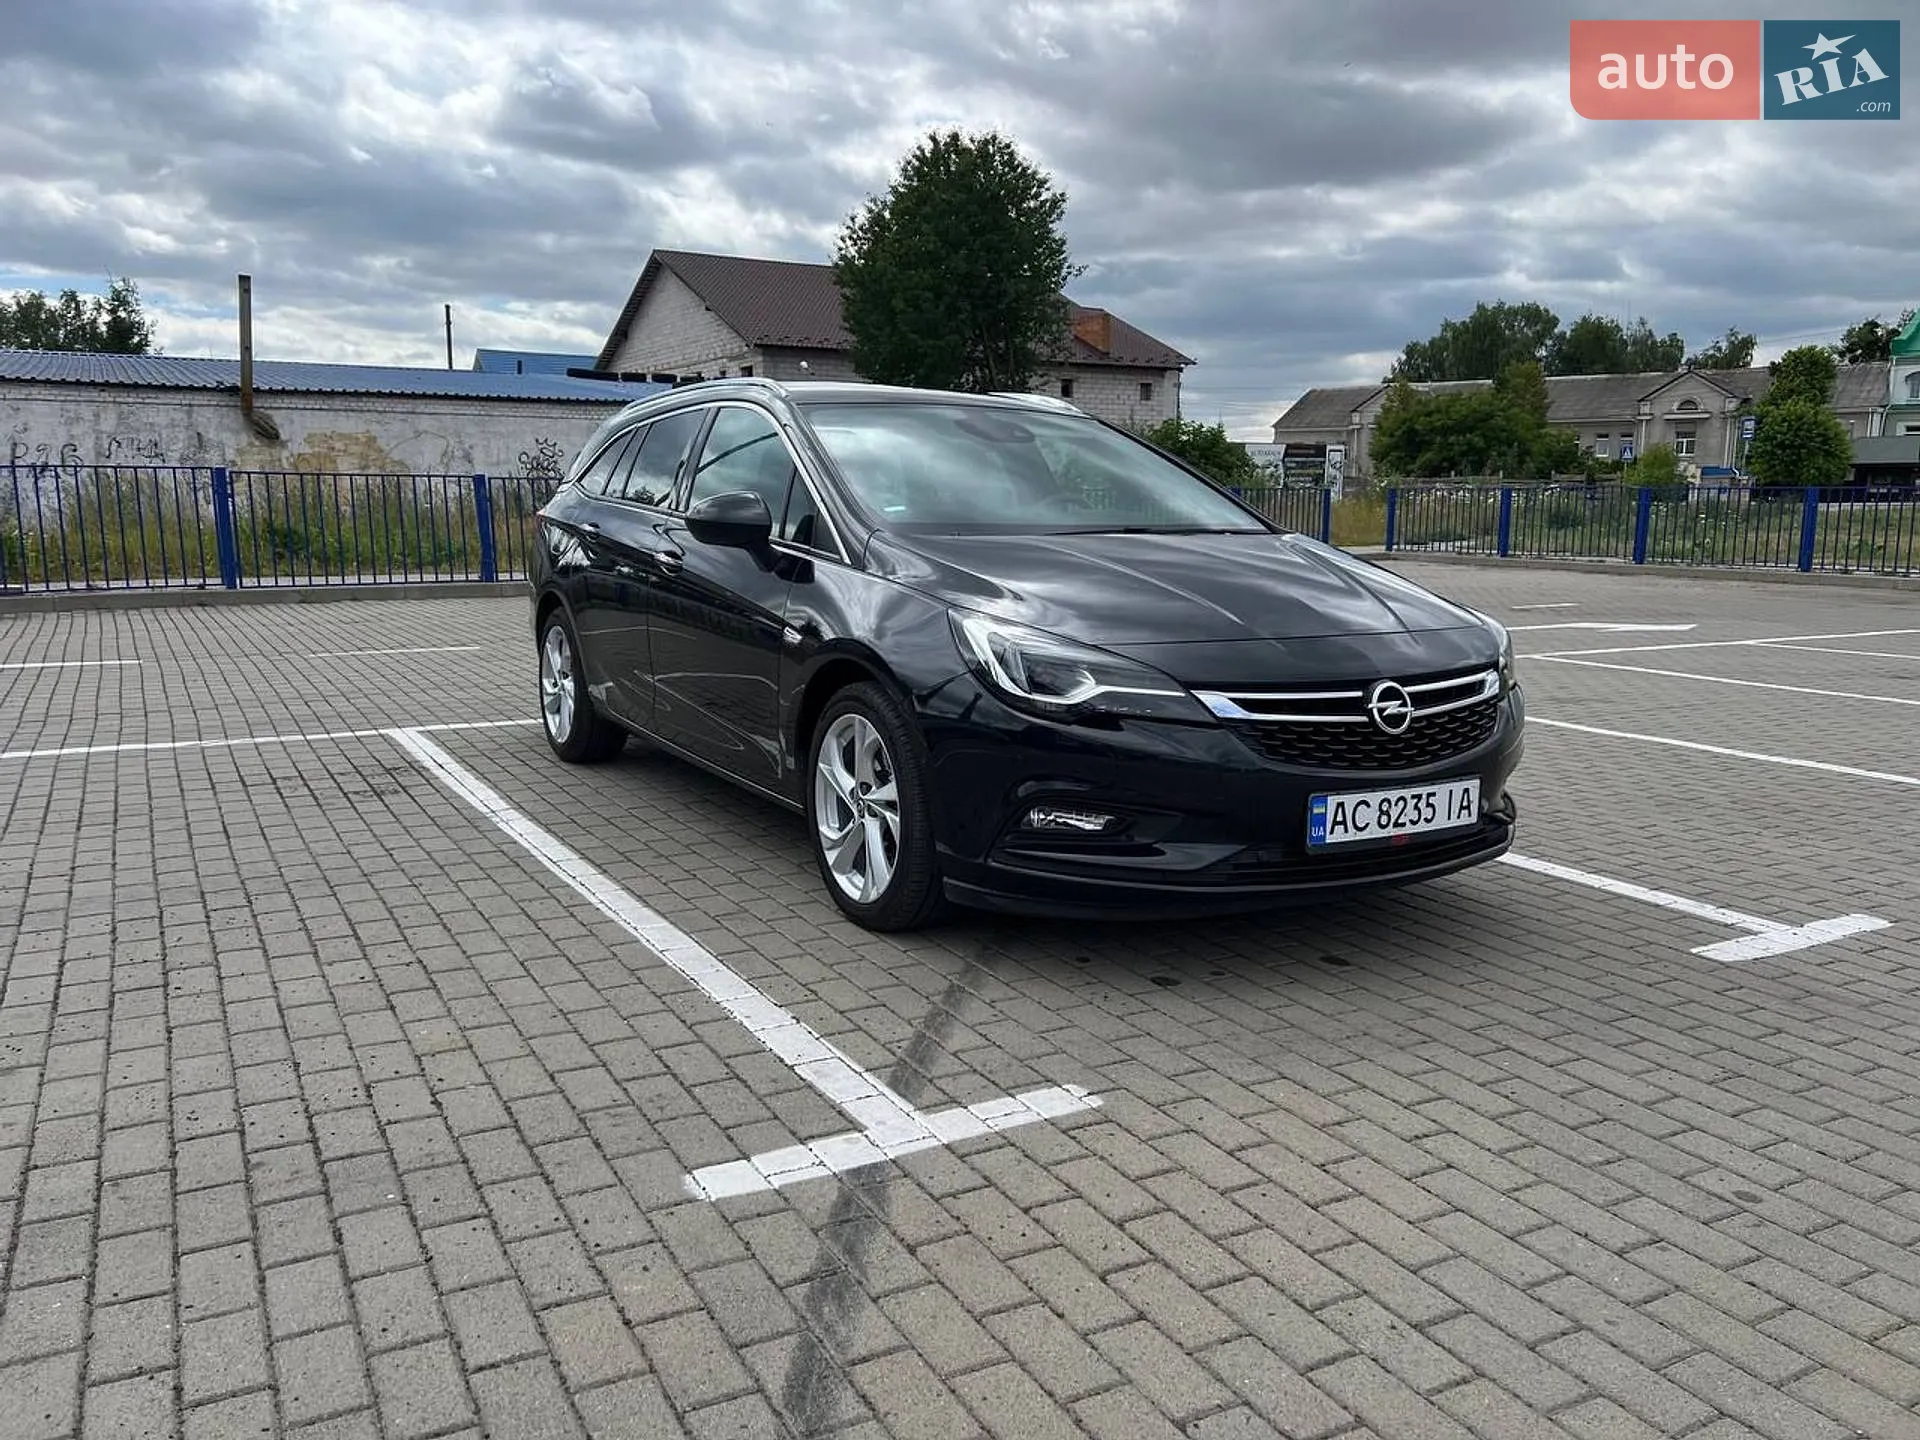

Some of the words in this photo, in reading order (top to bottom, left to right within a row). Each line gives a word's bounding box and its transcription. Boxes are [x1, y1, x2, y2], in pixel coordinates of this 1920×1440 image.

[1329, 799, 1371, 835] AC
[1376, 792, 1437, 830] 8235
[1447, 787, 1473, 821] IA
[1311, 826, 1325, 837] UA
